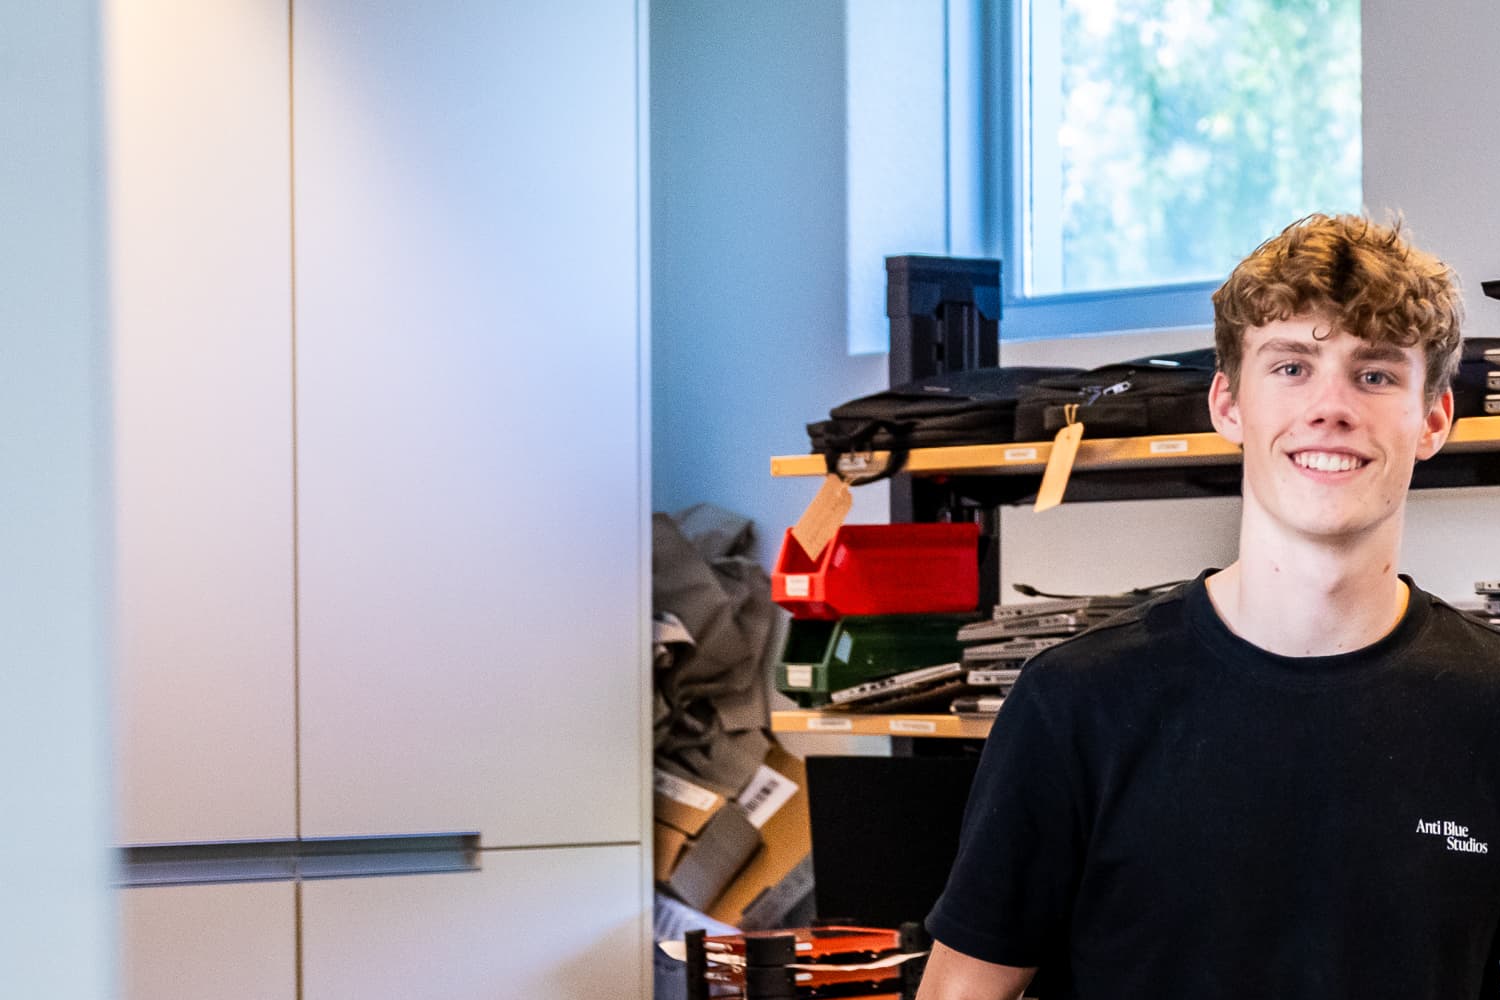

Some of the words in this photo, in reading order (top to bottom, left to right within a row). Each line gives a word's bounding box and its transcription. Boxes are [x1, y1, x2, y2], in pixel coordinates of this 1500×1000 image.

[1416, 819, 1440, 835] Anti
[1443, 821, 1469, 837] Blue
[1446, 836, 1488, 854] Studios
